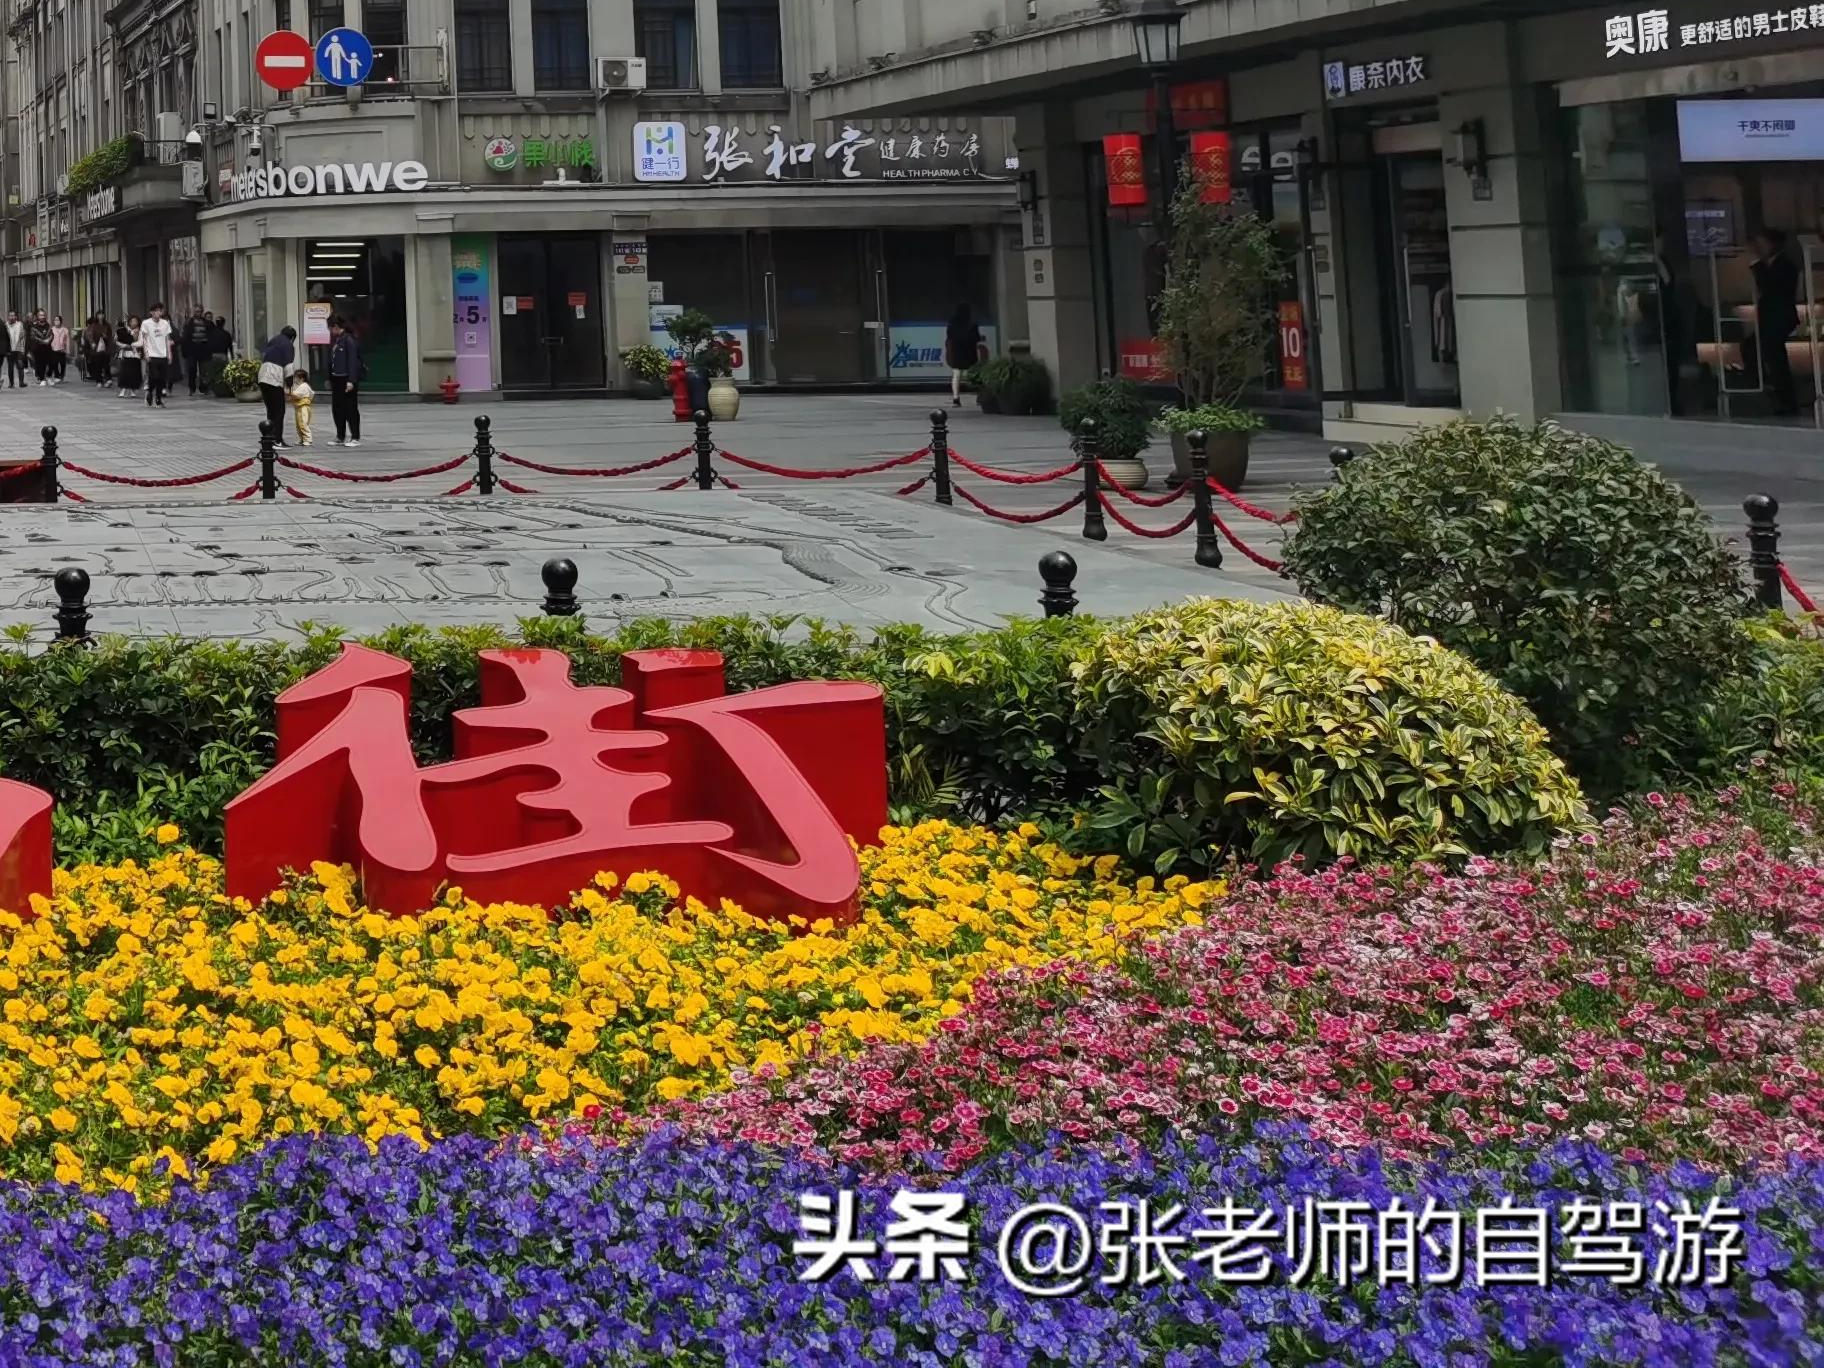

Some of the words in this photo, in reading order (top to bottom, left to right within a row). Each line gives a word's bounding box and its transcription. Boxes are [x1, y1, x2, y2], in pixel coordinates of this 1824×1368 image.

[1605, 9, 1669, 59] 奥康
[1348, 55, 1425, 92] 康奈内衣
[522, 140, 596, 168] 果小栈
[642, 157, 680, 170] 健一行
[702, 125, 875, 181] 张和堂
[882, 169, 920, 178] HEALTH
